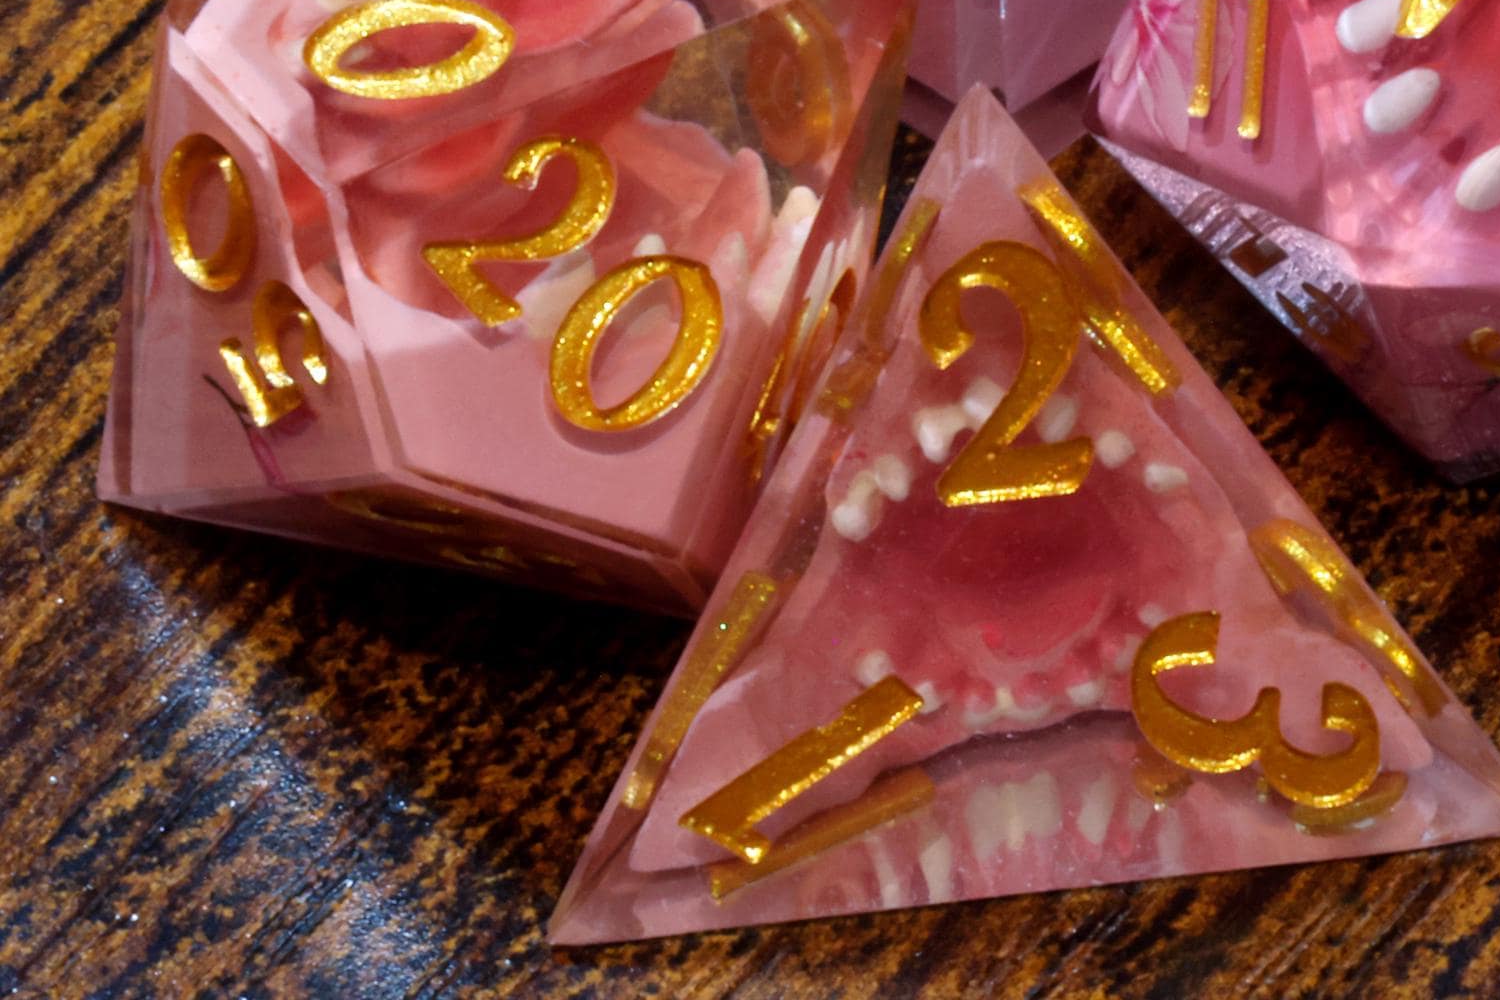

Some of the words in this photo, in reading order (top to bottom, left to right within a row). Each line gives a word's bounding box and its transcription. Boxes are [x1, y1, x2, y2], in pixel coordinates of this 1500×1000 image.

[420, 133, 725, 434] 20
[919, 238, 1097, 508] 2
[677, 673, 925, 866] 1
[1130, 610, 1382, 811] 3
